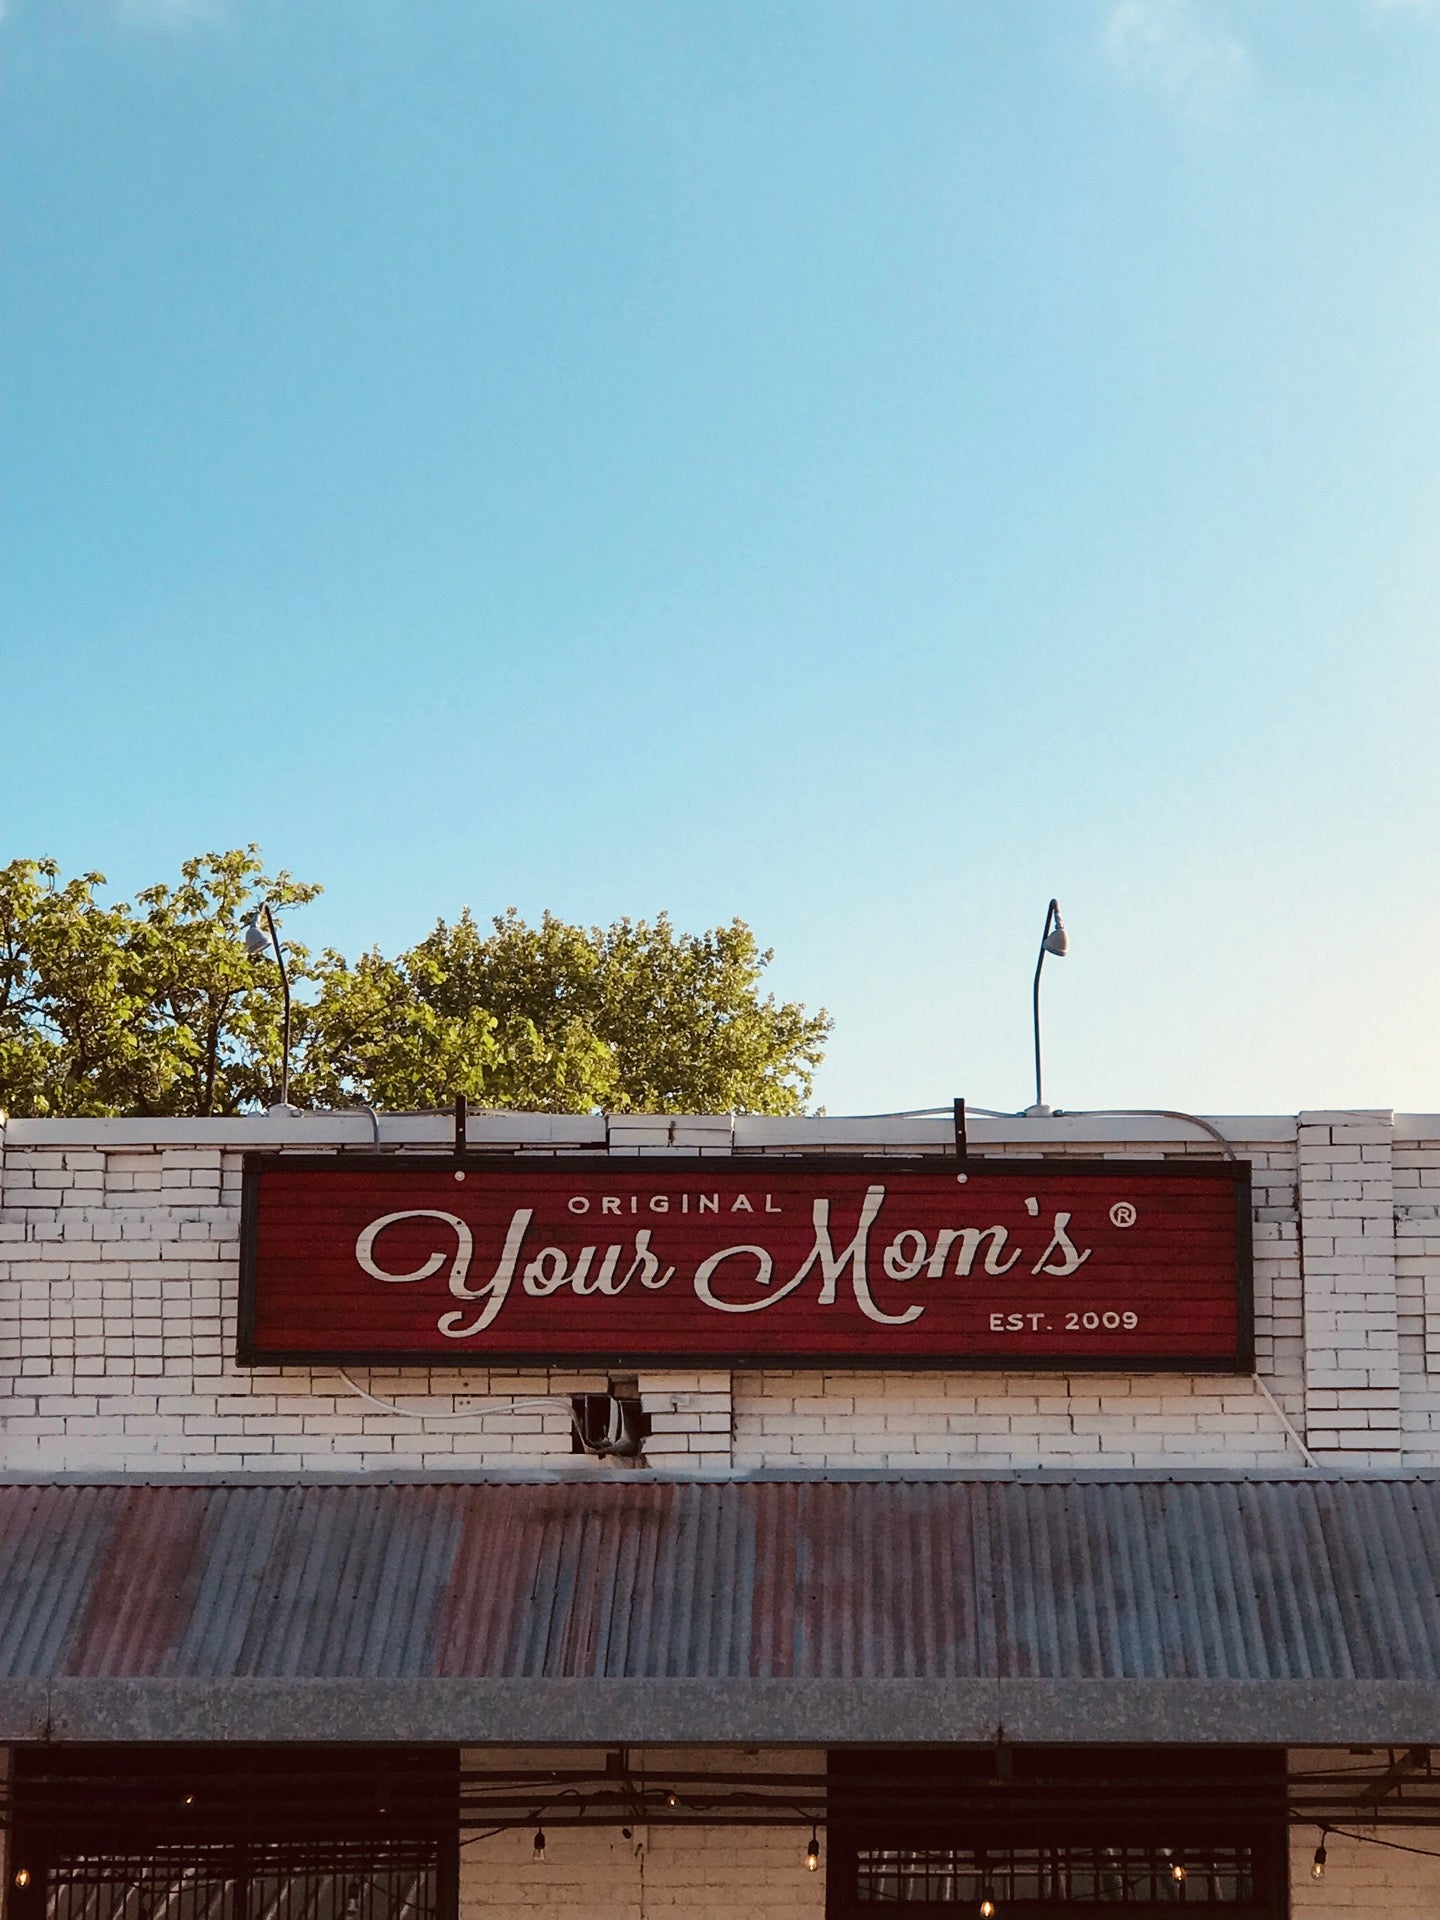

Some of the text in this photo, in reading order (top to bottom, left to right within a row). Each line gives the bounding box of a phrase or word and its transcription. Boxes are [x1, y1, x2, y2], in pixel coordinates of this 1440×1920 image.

[568, 1193, 782, 1214] ORIGINAL
[355, 1208, 676, 1338] Your
[693, 1184, 1092, 1325] Mom's
[989, 1311, 1138, 1331] EST. 2009
